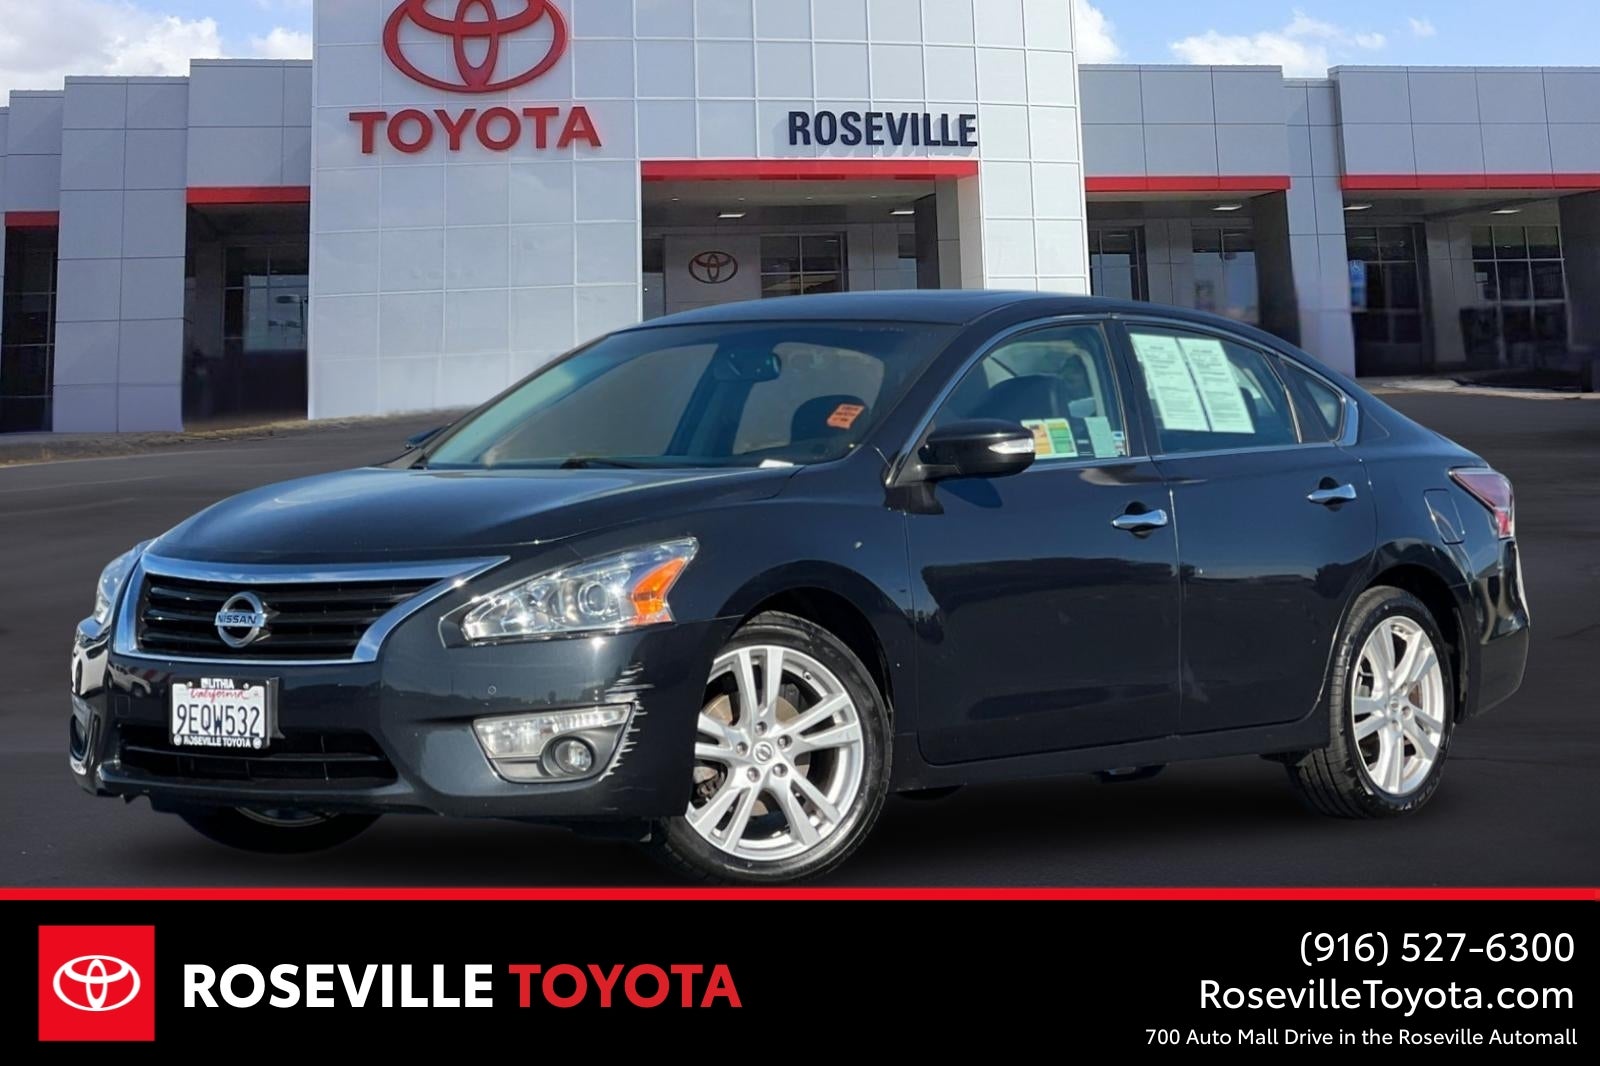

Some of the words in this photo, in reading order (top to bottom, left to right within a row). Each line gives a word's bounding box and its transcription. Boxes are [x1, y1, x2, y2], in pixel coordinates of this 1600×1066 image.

[349, 106, 602, 154] TOYOTA
[788, 110, 978, 147] ROSEVILLE
[218, 615, 257, 624] NISSAN
[177, 704, 260, 737] 9EQW532
[183, 736, 221, 747] ROSEVILLE
[223, 738, 251, 748] TOYOTA
